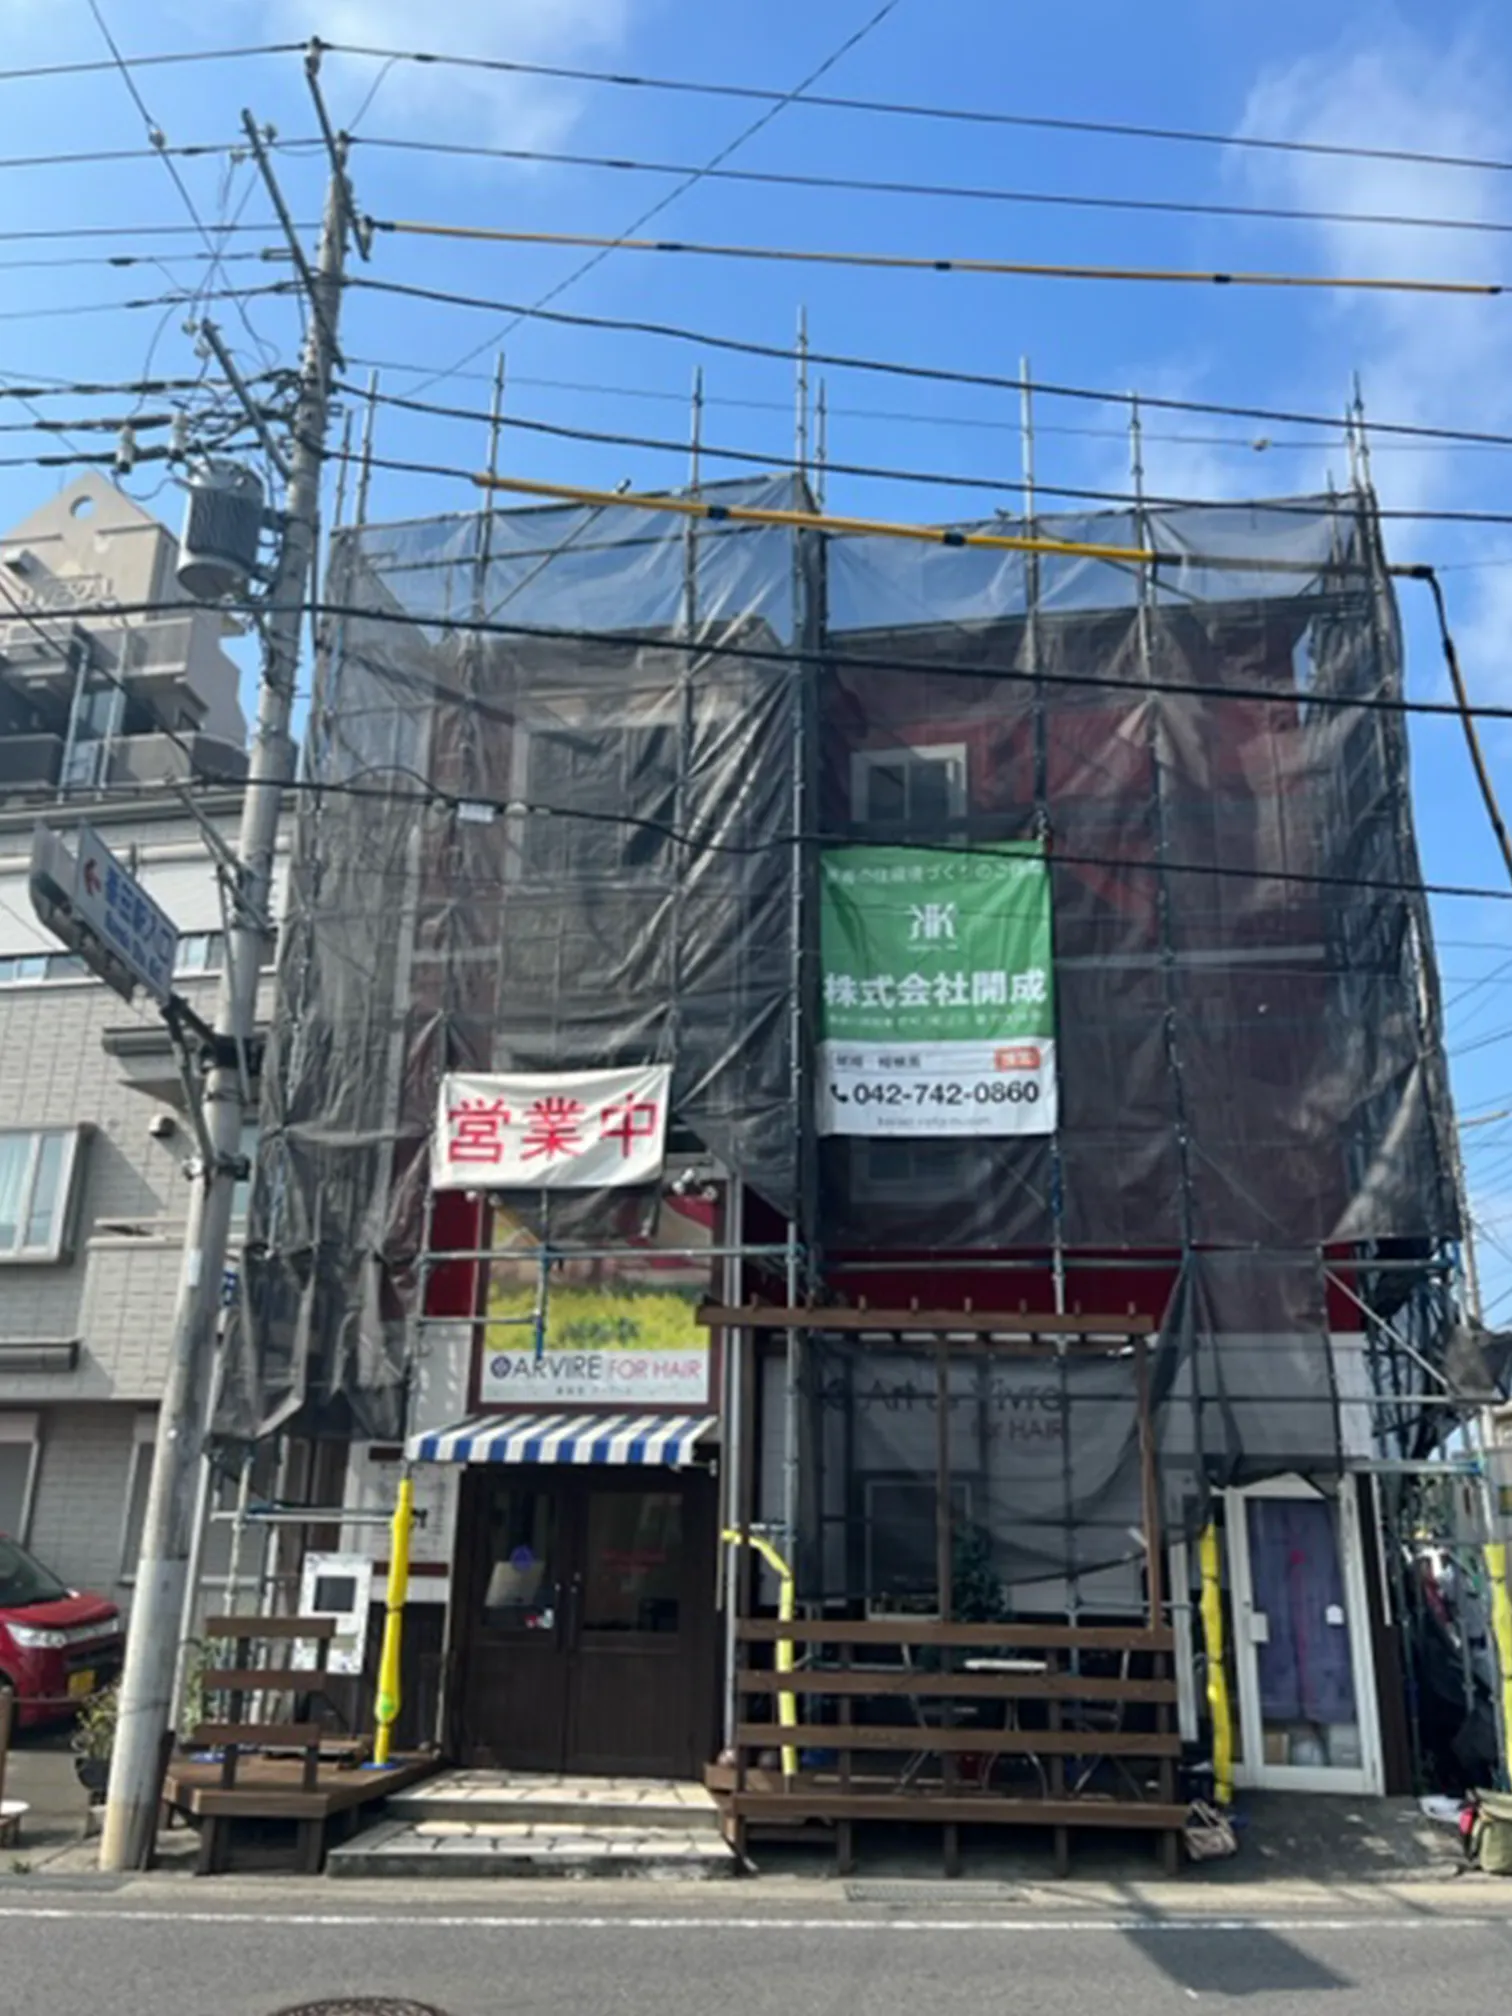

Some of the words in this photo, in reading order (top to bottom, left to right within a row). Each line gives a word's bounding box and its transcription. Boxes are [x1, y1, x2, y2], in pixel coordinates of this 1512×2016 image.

[853, 1081, 1040, 1105] 042-742-0860
[446, 1091, 658, 1164] 営業中
[609, 1358, 647, 1380] FOR
[653, 1358, 703, 1379] HAIR
